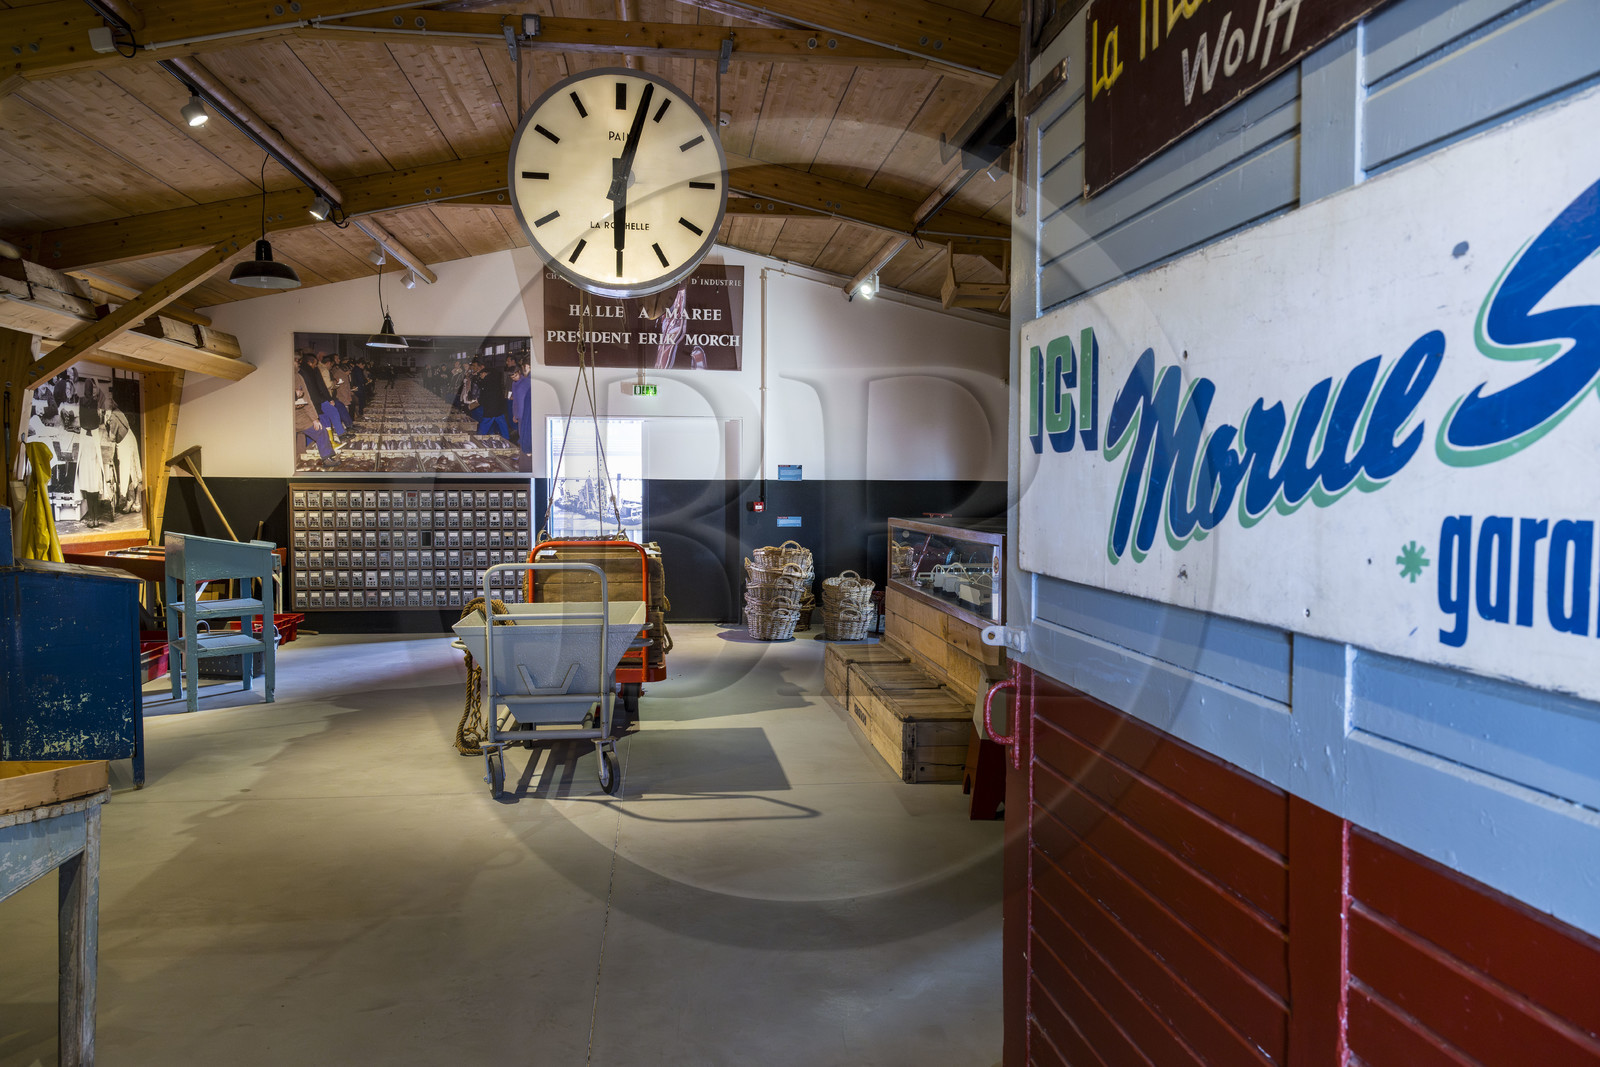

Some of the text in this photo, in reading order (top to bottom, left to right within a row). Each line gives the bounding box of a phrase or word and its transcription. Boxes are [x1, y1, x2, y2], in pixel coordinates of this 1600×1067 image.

[590, 221, 650, 231] LA ROHELLE
[568, 304, 722, 321] HALLE A MAREE
[546, 330, 741, 347] PRESIDENT ERIK MORCH
[1029, 326, 1099, 455] ICI
[1103, 329, 1446, 566] Morue
[1437, 514, 1600, 649] gara
